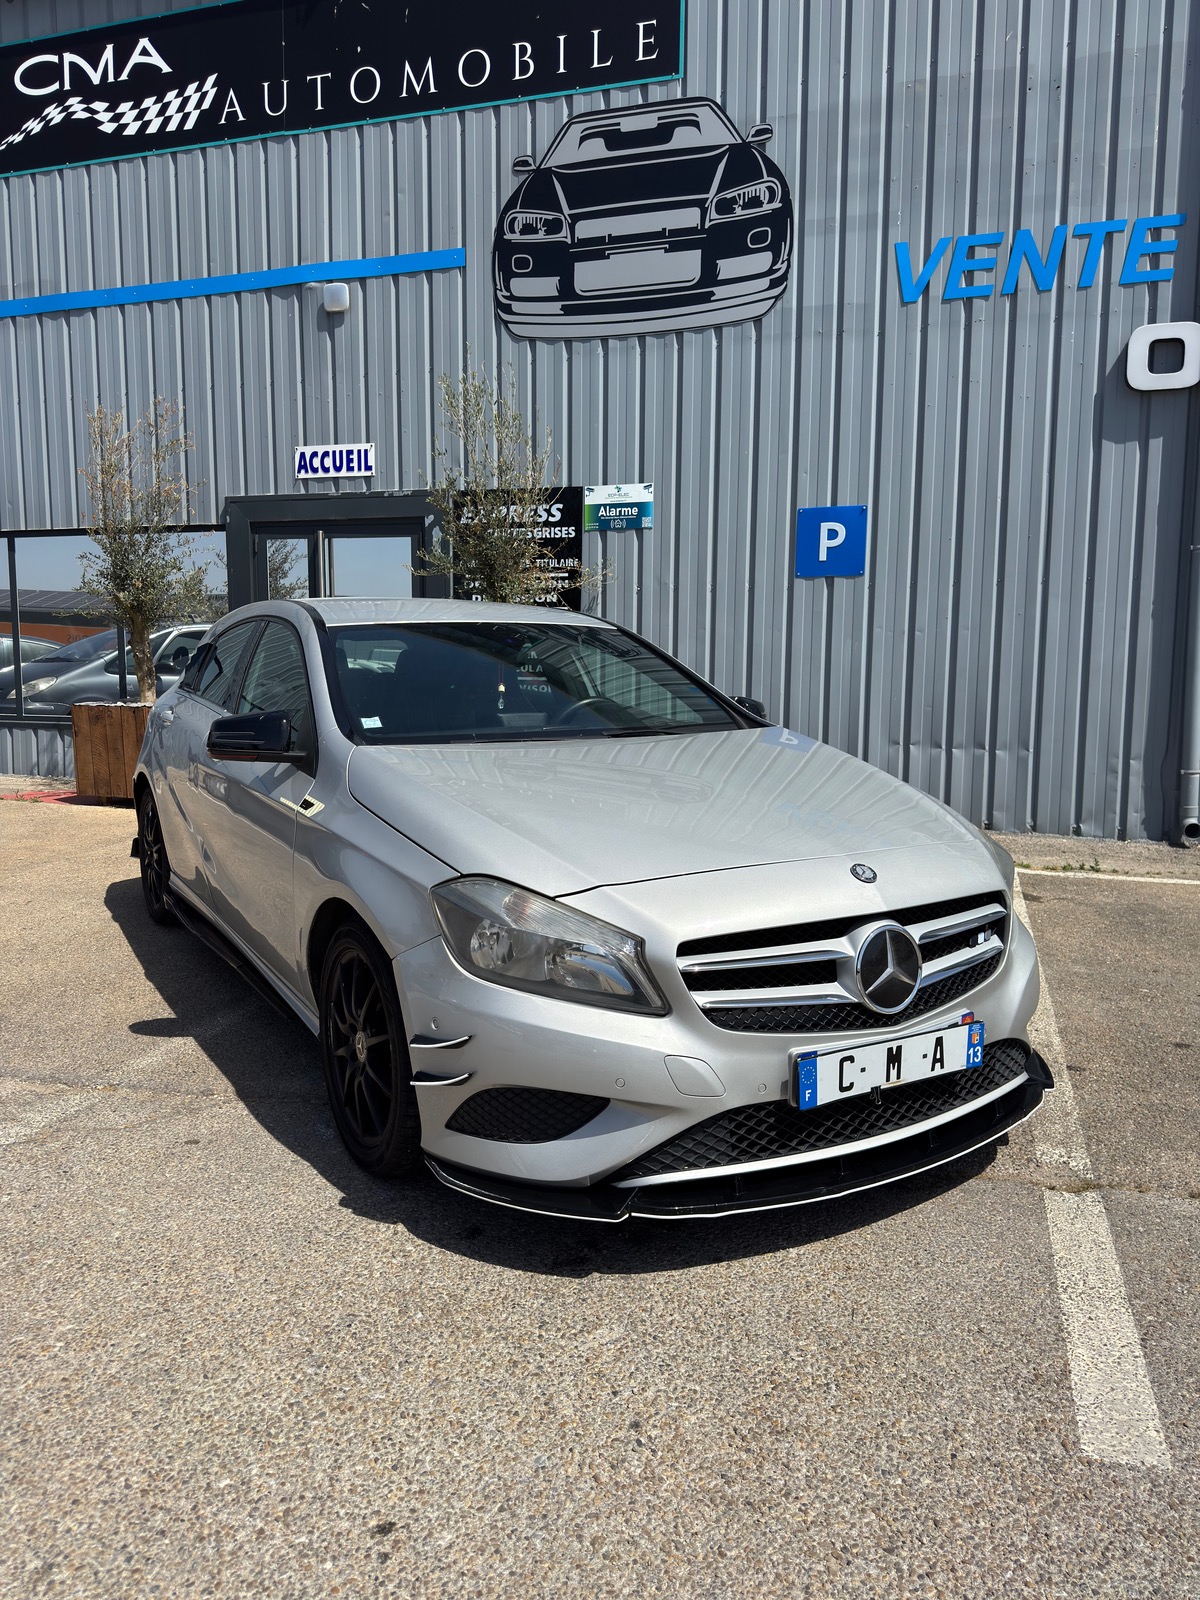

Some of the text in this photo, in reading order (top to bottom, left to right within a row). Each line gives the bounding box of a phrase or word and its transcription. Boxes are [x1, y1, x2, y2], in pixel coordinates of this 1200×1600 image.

[13, 36, 173, 96] CMA
[218, 19, 660, 126] AUTOMOBILE
[894, 212, 1187, 304] VENTE
[296, 448, 373, 475] ACCUEIL
[598, 505, 639, 517] Alarme
[533, 526, 576, 539] GRISES
[818, 521, 847, 562] P
[535, 558, 579, 568] TITULAIRE
[885, 1044, 903, 1083] M
[967, 1046, 982, 1064] 13
[805, 1089, 812, 1102] F
